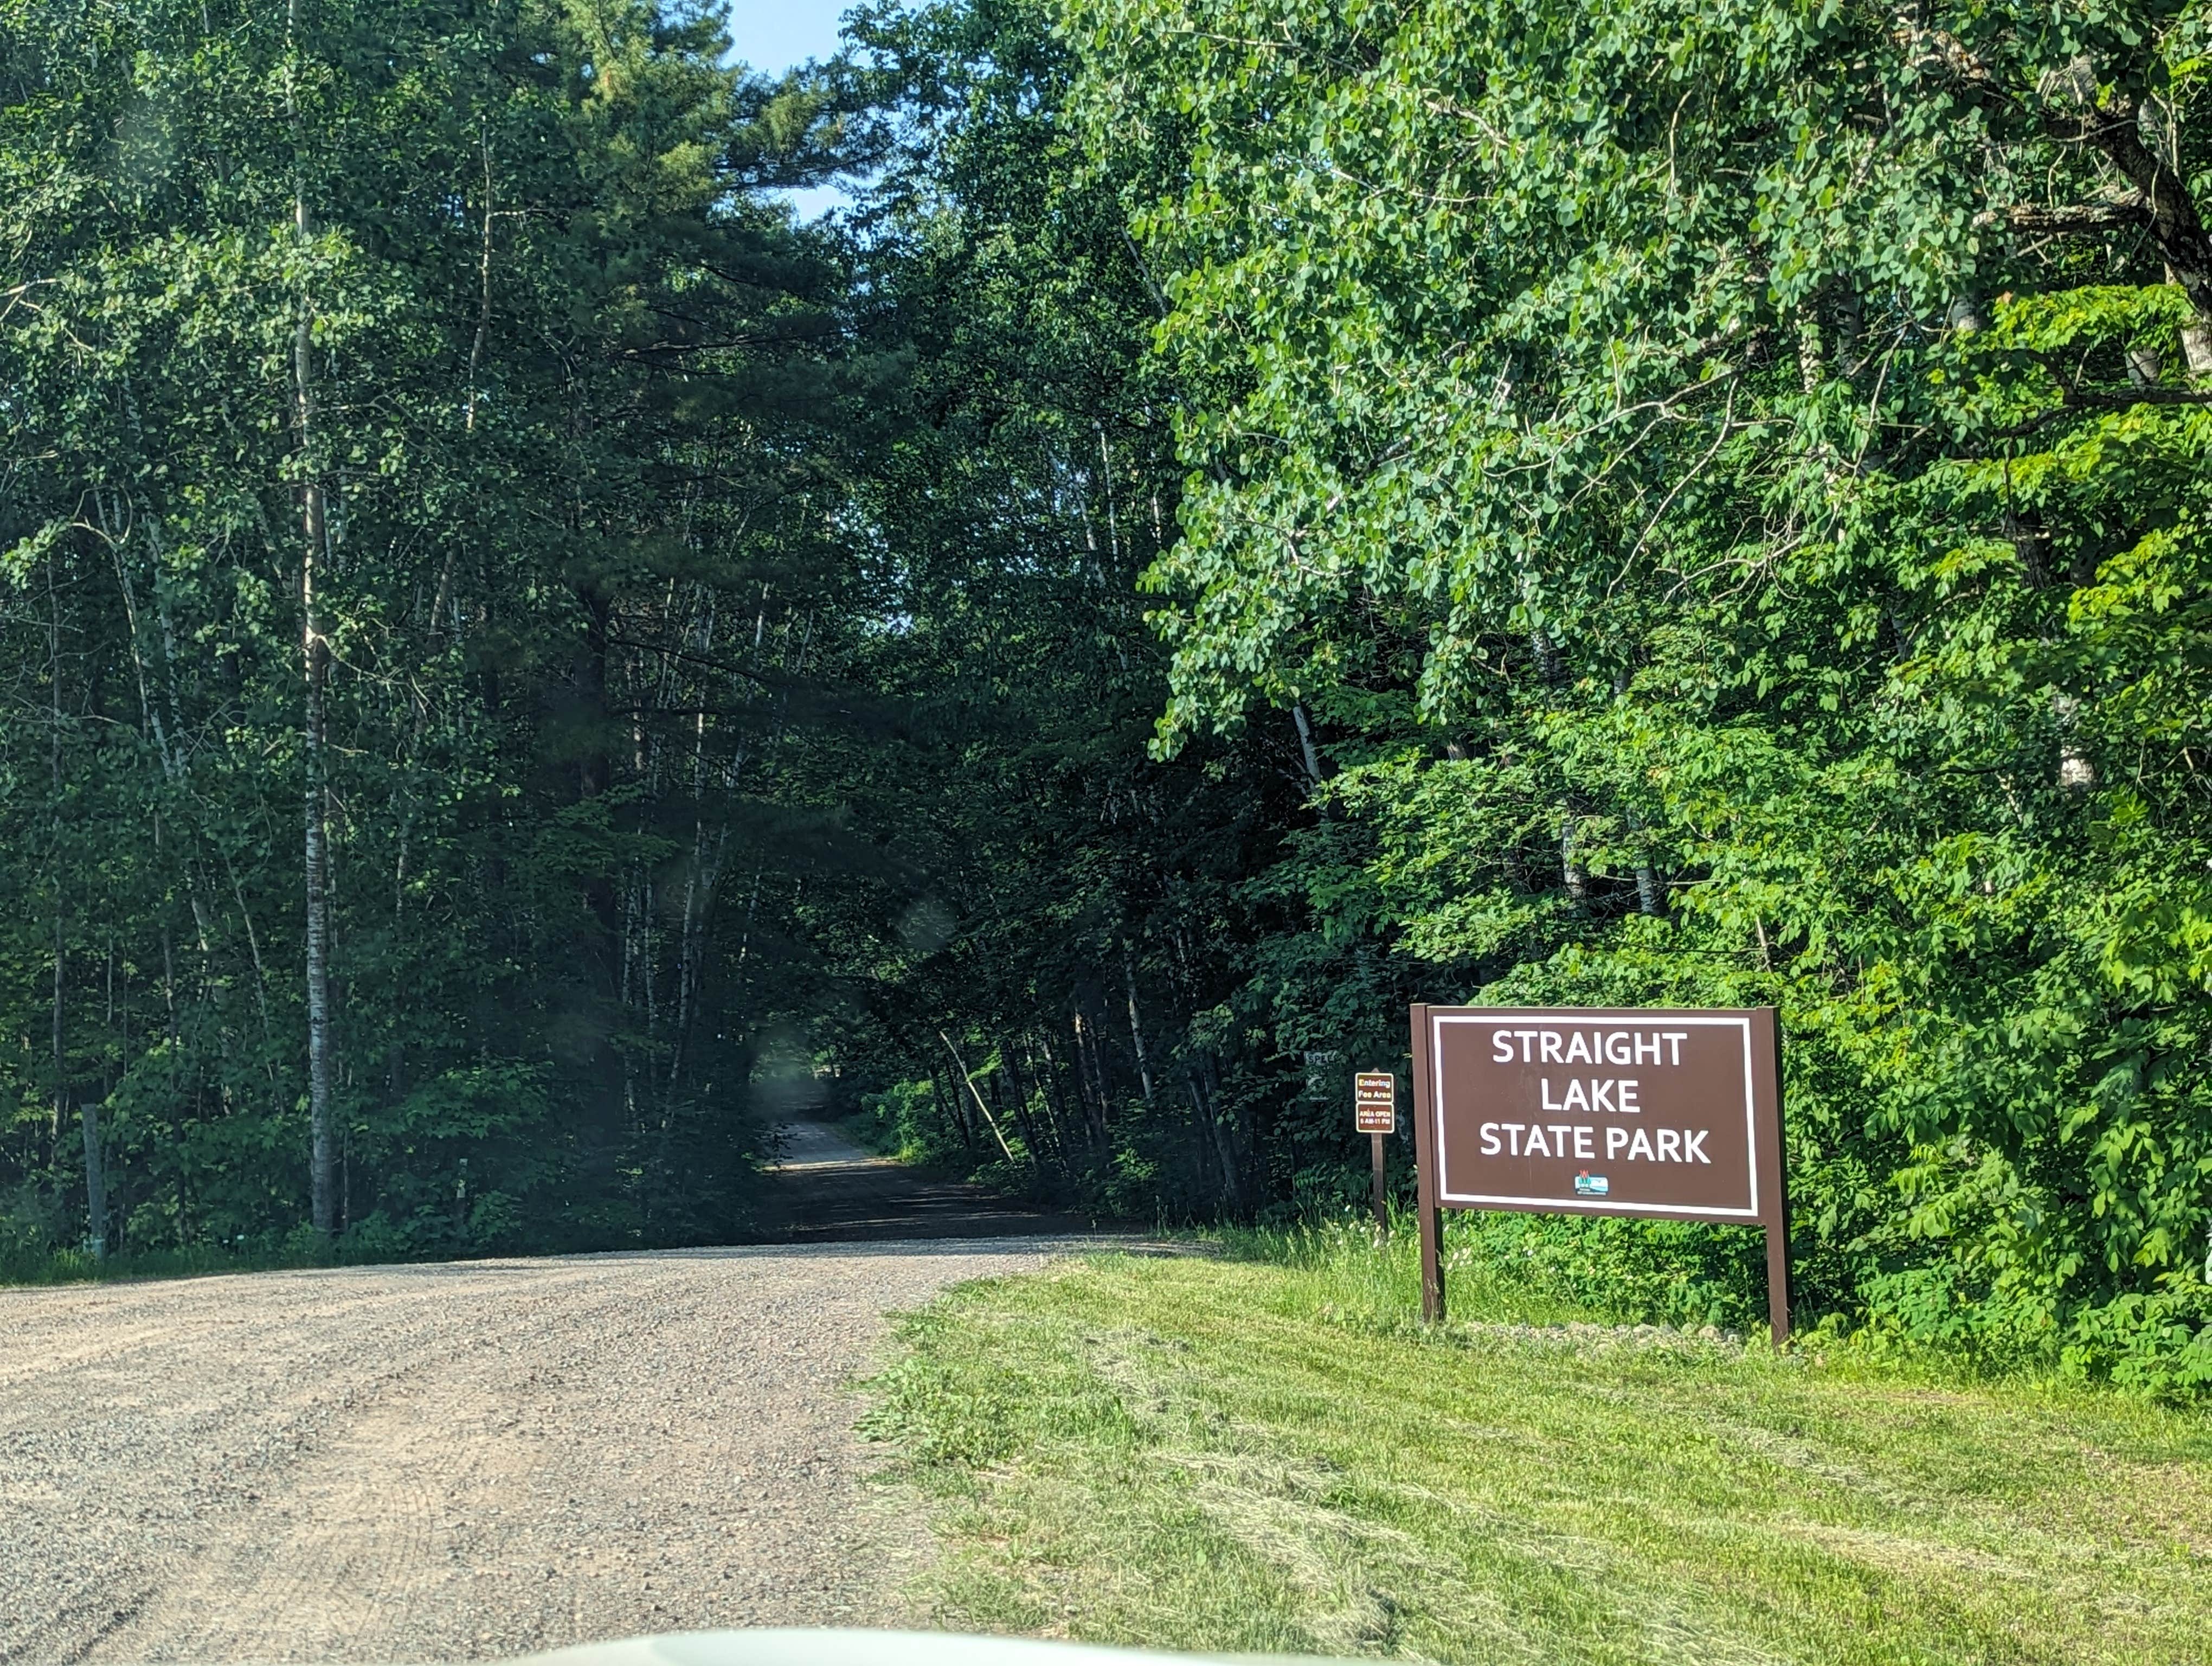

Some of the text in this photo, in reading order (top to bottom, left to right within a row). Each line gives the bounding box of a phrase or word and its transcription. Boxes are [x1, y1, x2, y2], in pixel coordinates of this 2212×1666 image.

[1492, 1030, 1688, 1066] STRAIGHT
[1358, 1079, 1391, 1088] Entering
[1358, 1090, 1372, 1098] Fee
[1541, 1078, 1641, 1113] LAKE
[1480, 1122, 1711, 1163] STATE PARK
